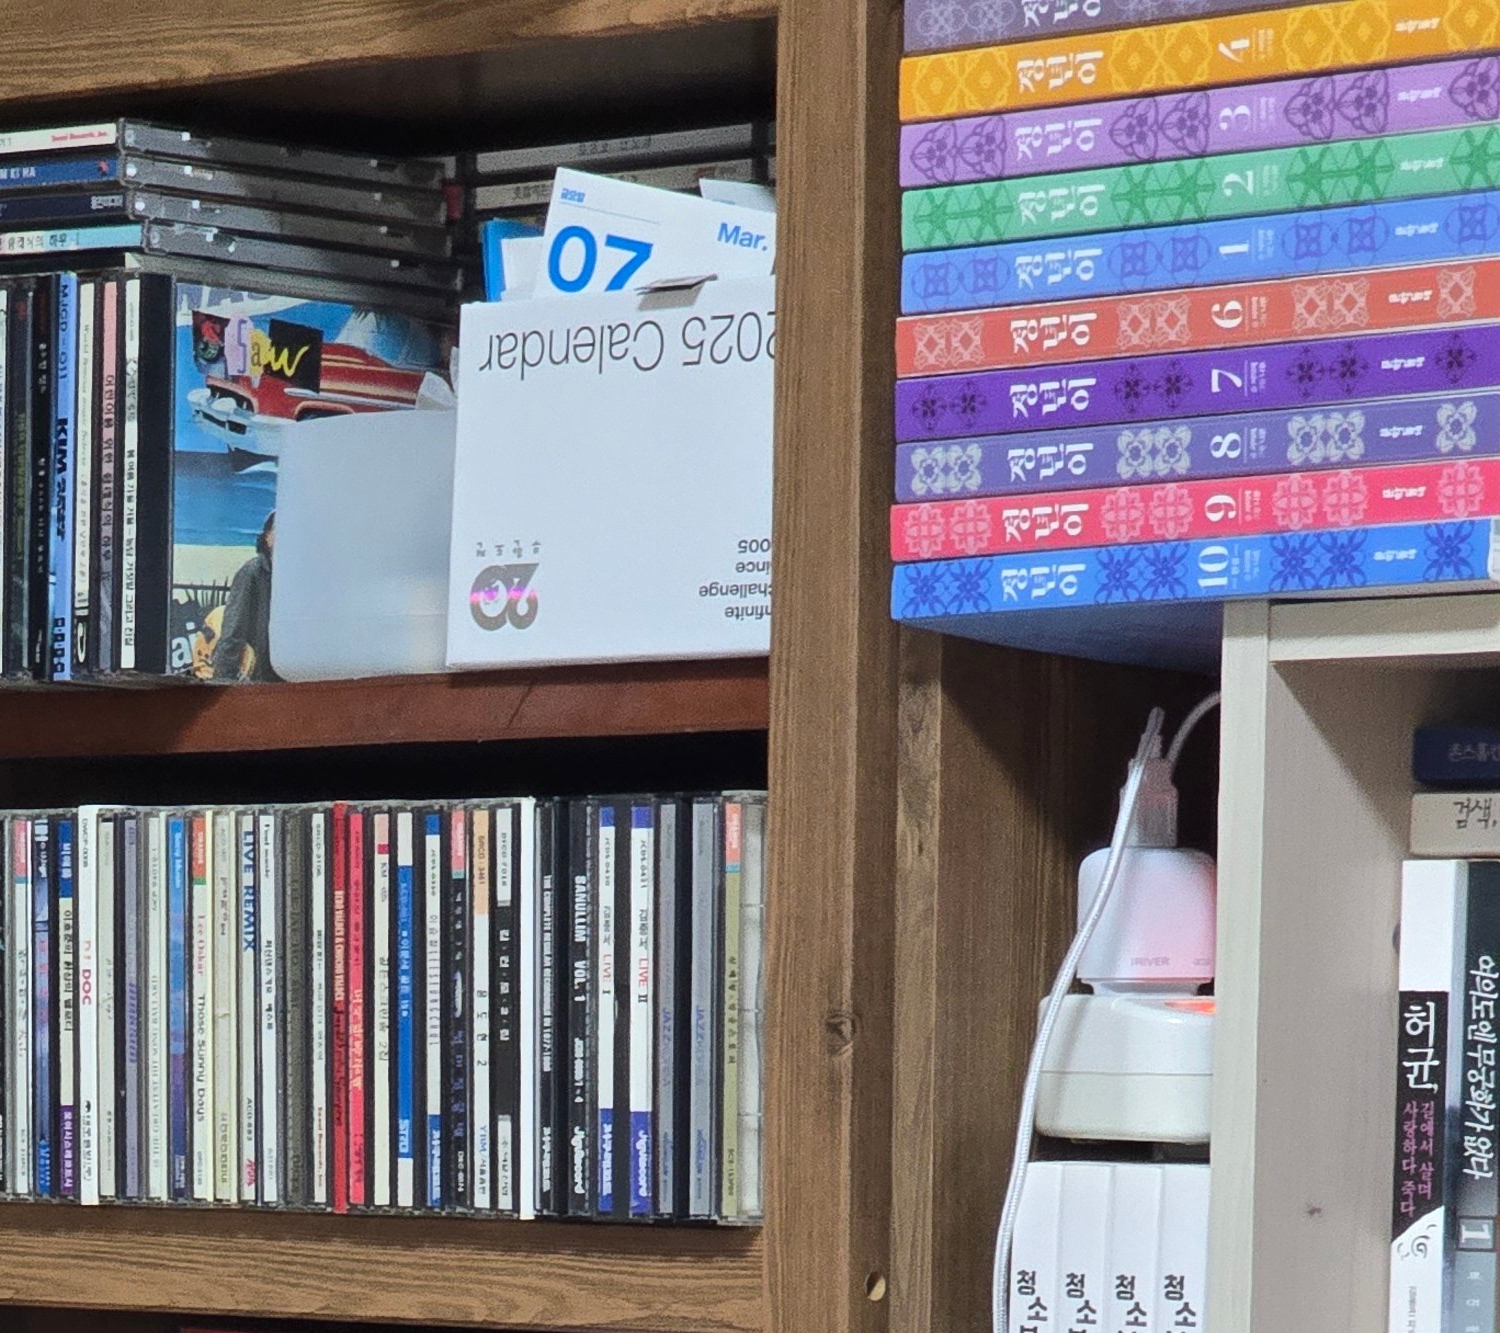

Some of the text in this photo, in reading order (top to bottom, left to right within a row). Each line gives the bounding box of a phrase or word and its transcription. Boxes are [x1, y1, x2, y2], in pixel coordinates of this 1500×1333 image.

[1016, 49, 1103, 94] 정년이
[1218, 37, 1250, 61] 4
[1014, 104, 1251, 160] 정년이 3
[1017, 169, 1255, 224] 정년이 2
[547, 225, 654, 293] 07
[717, 222, 769, 251] Mar.
[1015, 242, 1250, 289] 정년이 1
[478, 320, 664, 380] Calendar
[1009, 312, 1098, 354] 정년이
[1211, 300, 1245, 329] 6
[1008, 367, 1244, 419] 정년이 7
[57, 417, 68, 475] KIM
[1006, 431, 1243, 483] 정년이 8
[1001, 493, 1237, 543] 정년이 9
[736, 561, 772, 574] ince
[1001, 546, 1230, 601] 정년이 10
[469, 563, 539, 632] 20
[243, 830, 256, 952] LIVE REMIX
[196, 939, 206, 976] Oskar
[574, 875, 586, 990] SANULLIM VOL.
[82, 968, 91, 1006] DOC
[603, 954, 612, 982] LIVE
[639, 957, 648, 987] LIVE
[194, 1040, 205, 1082] Sunny
[1463, 954, 1499, 1180] 여의도엔 무궁화가 없다
[195, 1088, 206, 1122] Days
[1420, 1101, 1434, 1156] 길에서
[1403, 1101, 1417, 1174] 사랑하다
